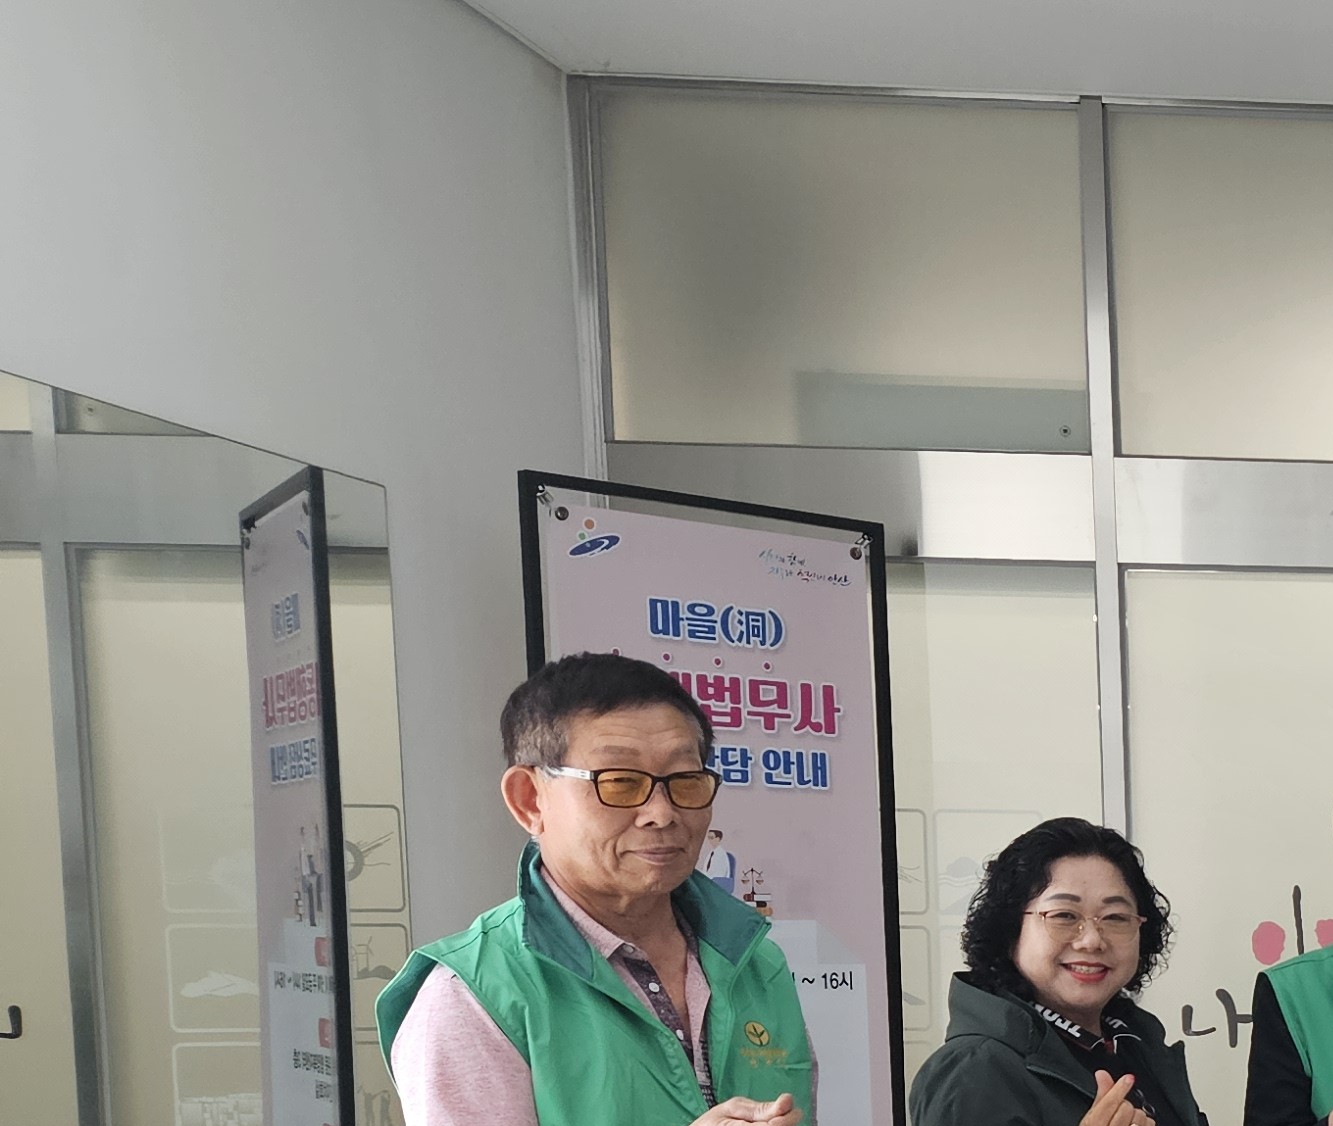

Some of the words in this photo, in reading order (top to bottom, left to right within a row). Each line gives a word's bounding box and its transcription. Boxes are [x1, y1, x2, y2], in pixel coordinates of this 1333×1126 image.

[648, 597, 784, 648] 마을(洞)
[762, 749, 831, 789] 안내
[821, 971, 853, 990] 16시
